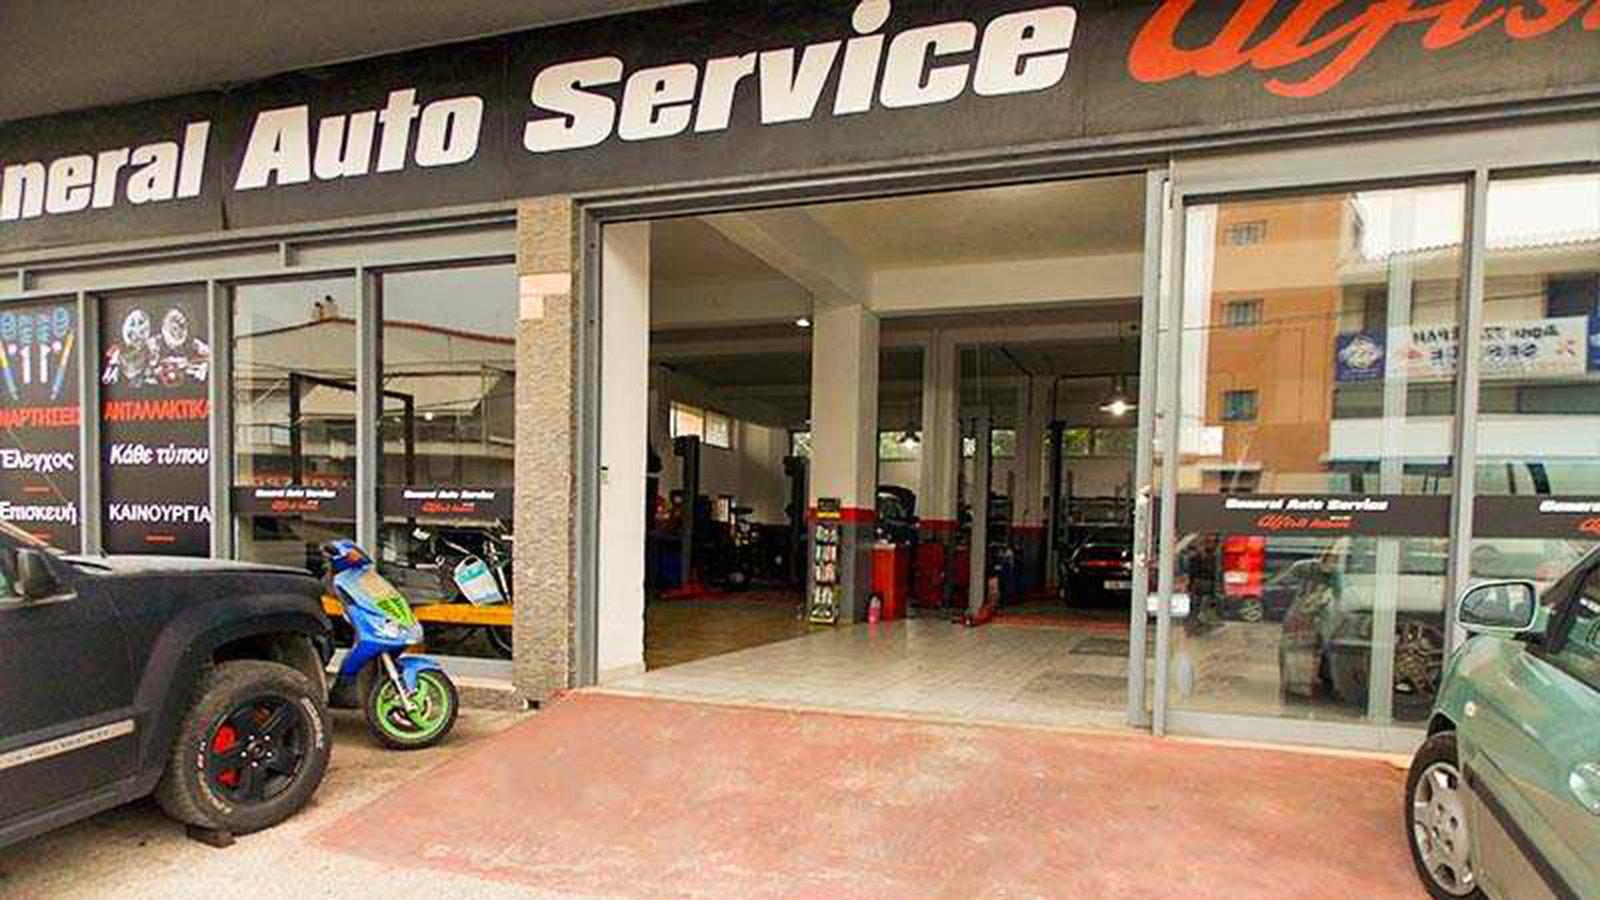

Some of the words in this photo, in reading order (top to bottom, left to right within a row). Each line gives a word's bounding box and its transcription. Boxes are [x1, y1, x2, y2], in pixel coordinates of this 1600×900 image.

[234, 88, 484, 191] Auto
[523, 0, 1077, 153] Service
[110, 443, 154, 465] Κάθε
[156, 443, 209, 465] τύπου
[109, 504, 212, 522] ΚΑΙΝΟΥΡΓΙΑ
